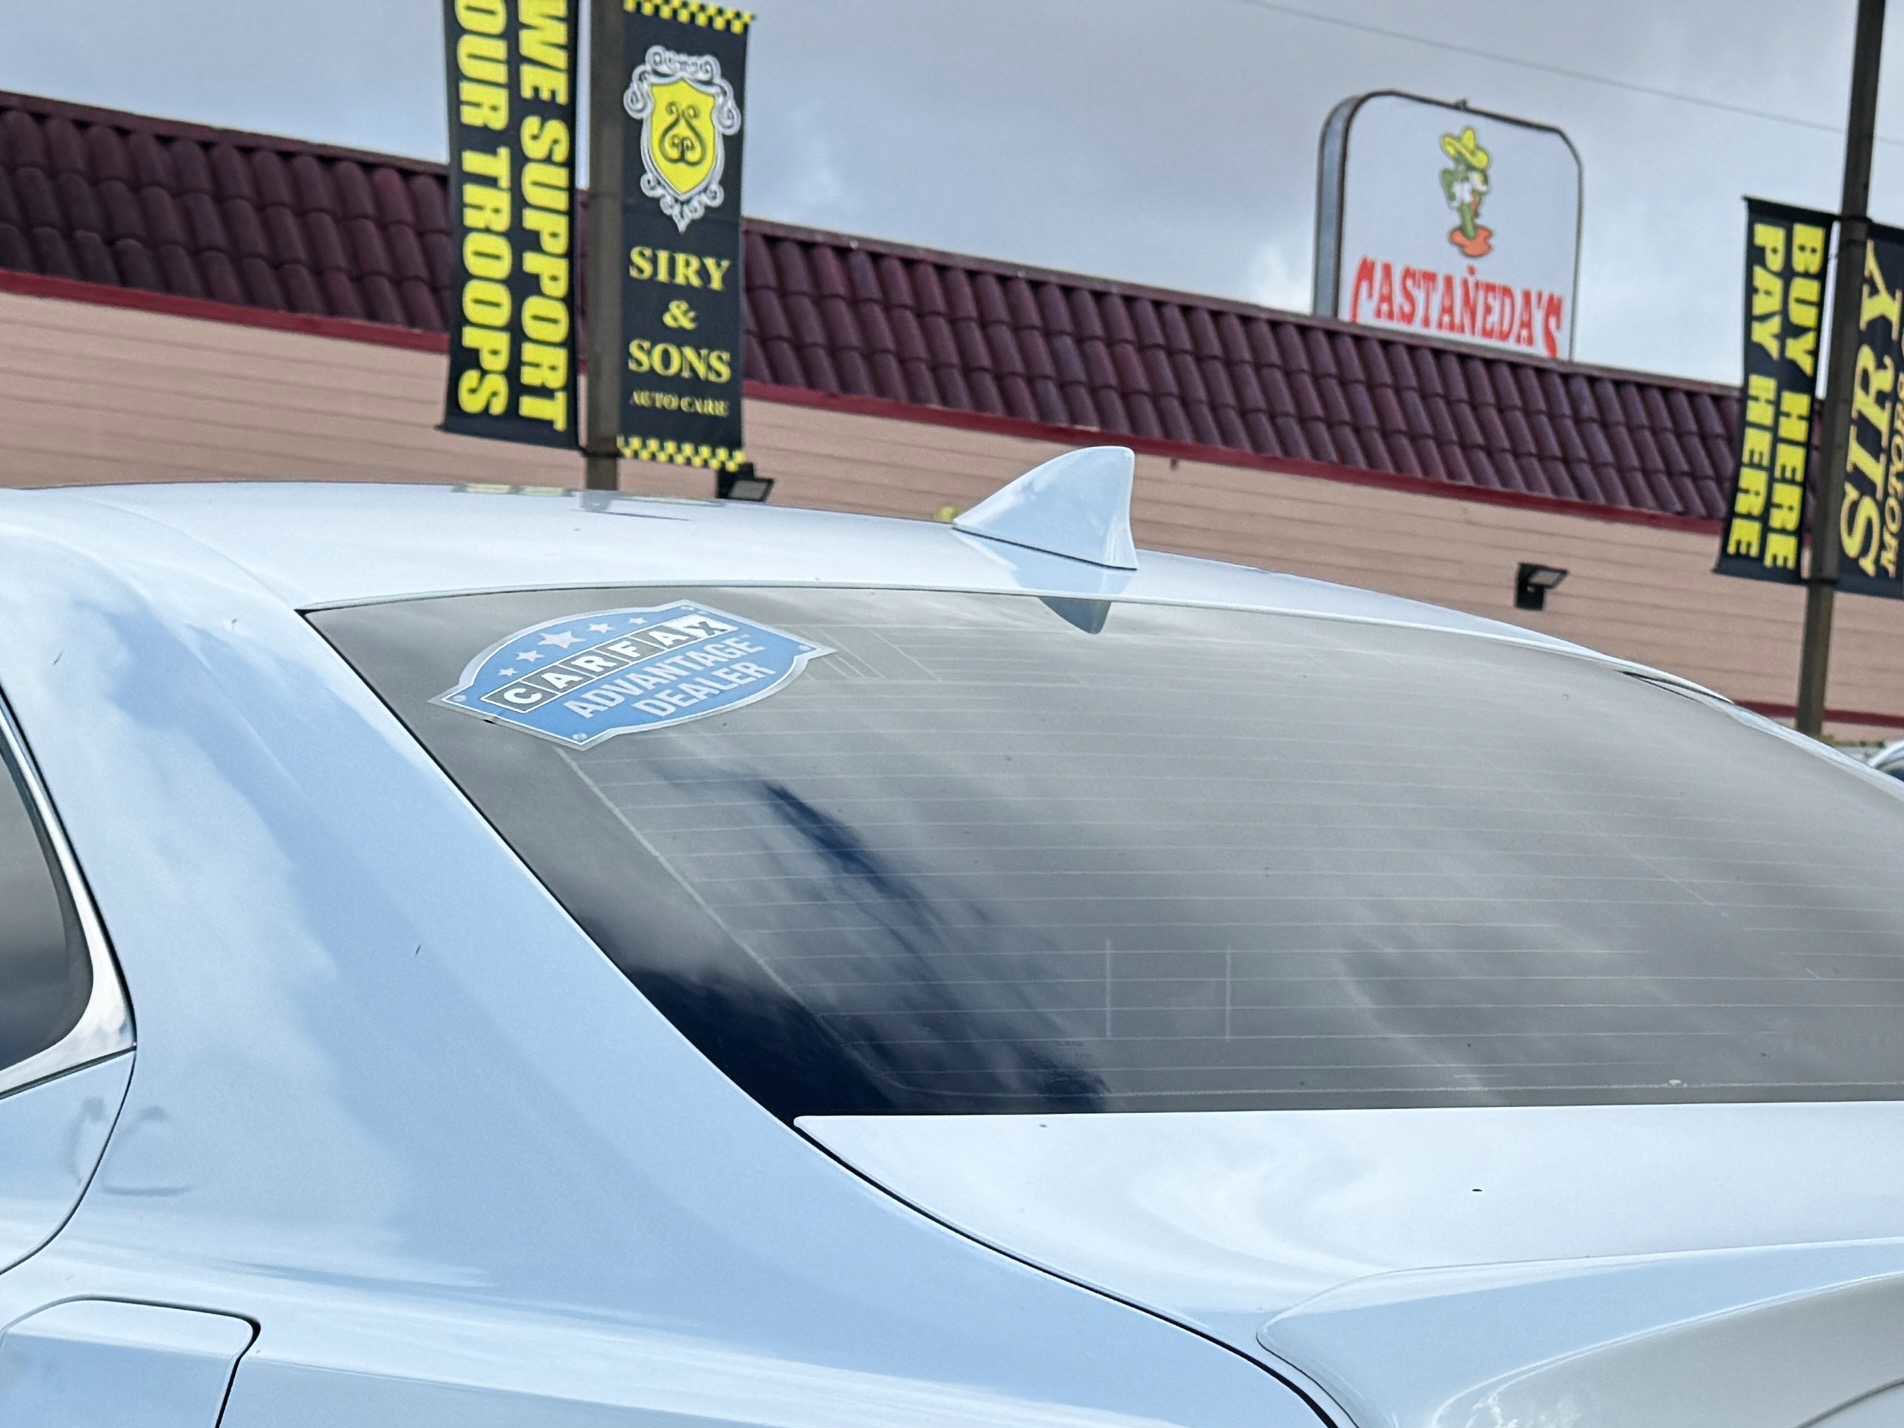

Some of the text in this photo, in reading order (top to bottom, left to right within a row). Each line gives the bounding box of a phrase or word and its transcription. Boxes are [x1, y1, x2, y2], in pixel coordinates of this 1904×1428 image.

[454, 0, 512, 417] OUR TROOPS
[518, 0, 570, 432] WE SUPPORT
[628, 245, 731, 292] SIRY
[1349, 254, 1564, 360] CASTAÑEDA'S
[662, 299, 698, 331] &
[628, 338, 732, 384] SONS
[632, 388, 730, 419] AUTO CARE
[1727, 222, 1787, 558] PAY HERE
[1763, 221, 1826, 570] BUY HERE
[1839, 238, 1902, 577] SIRY
[501, 618, 730, 706] CARFAX
[562, 638, 768, 720] ADVANTAGE
[631, 659, 778, 718] DEALER
